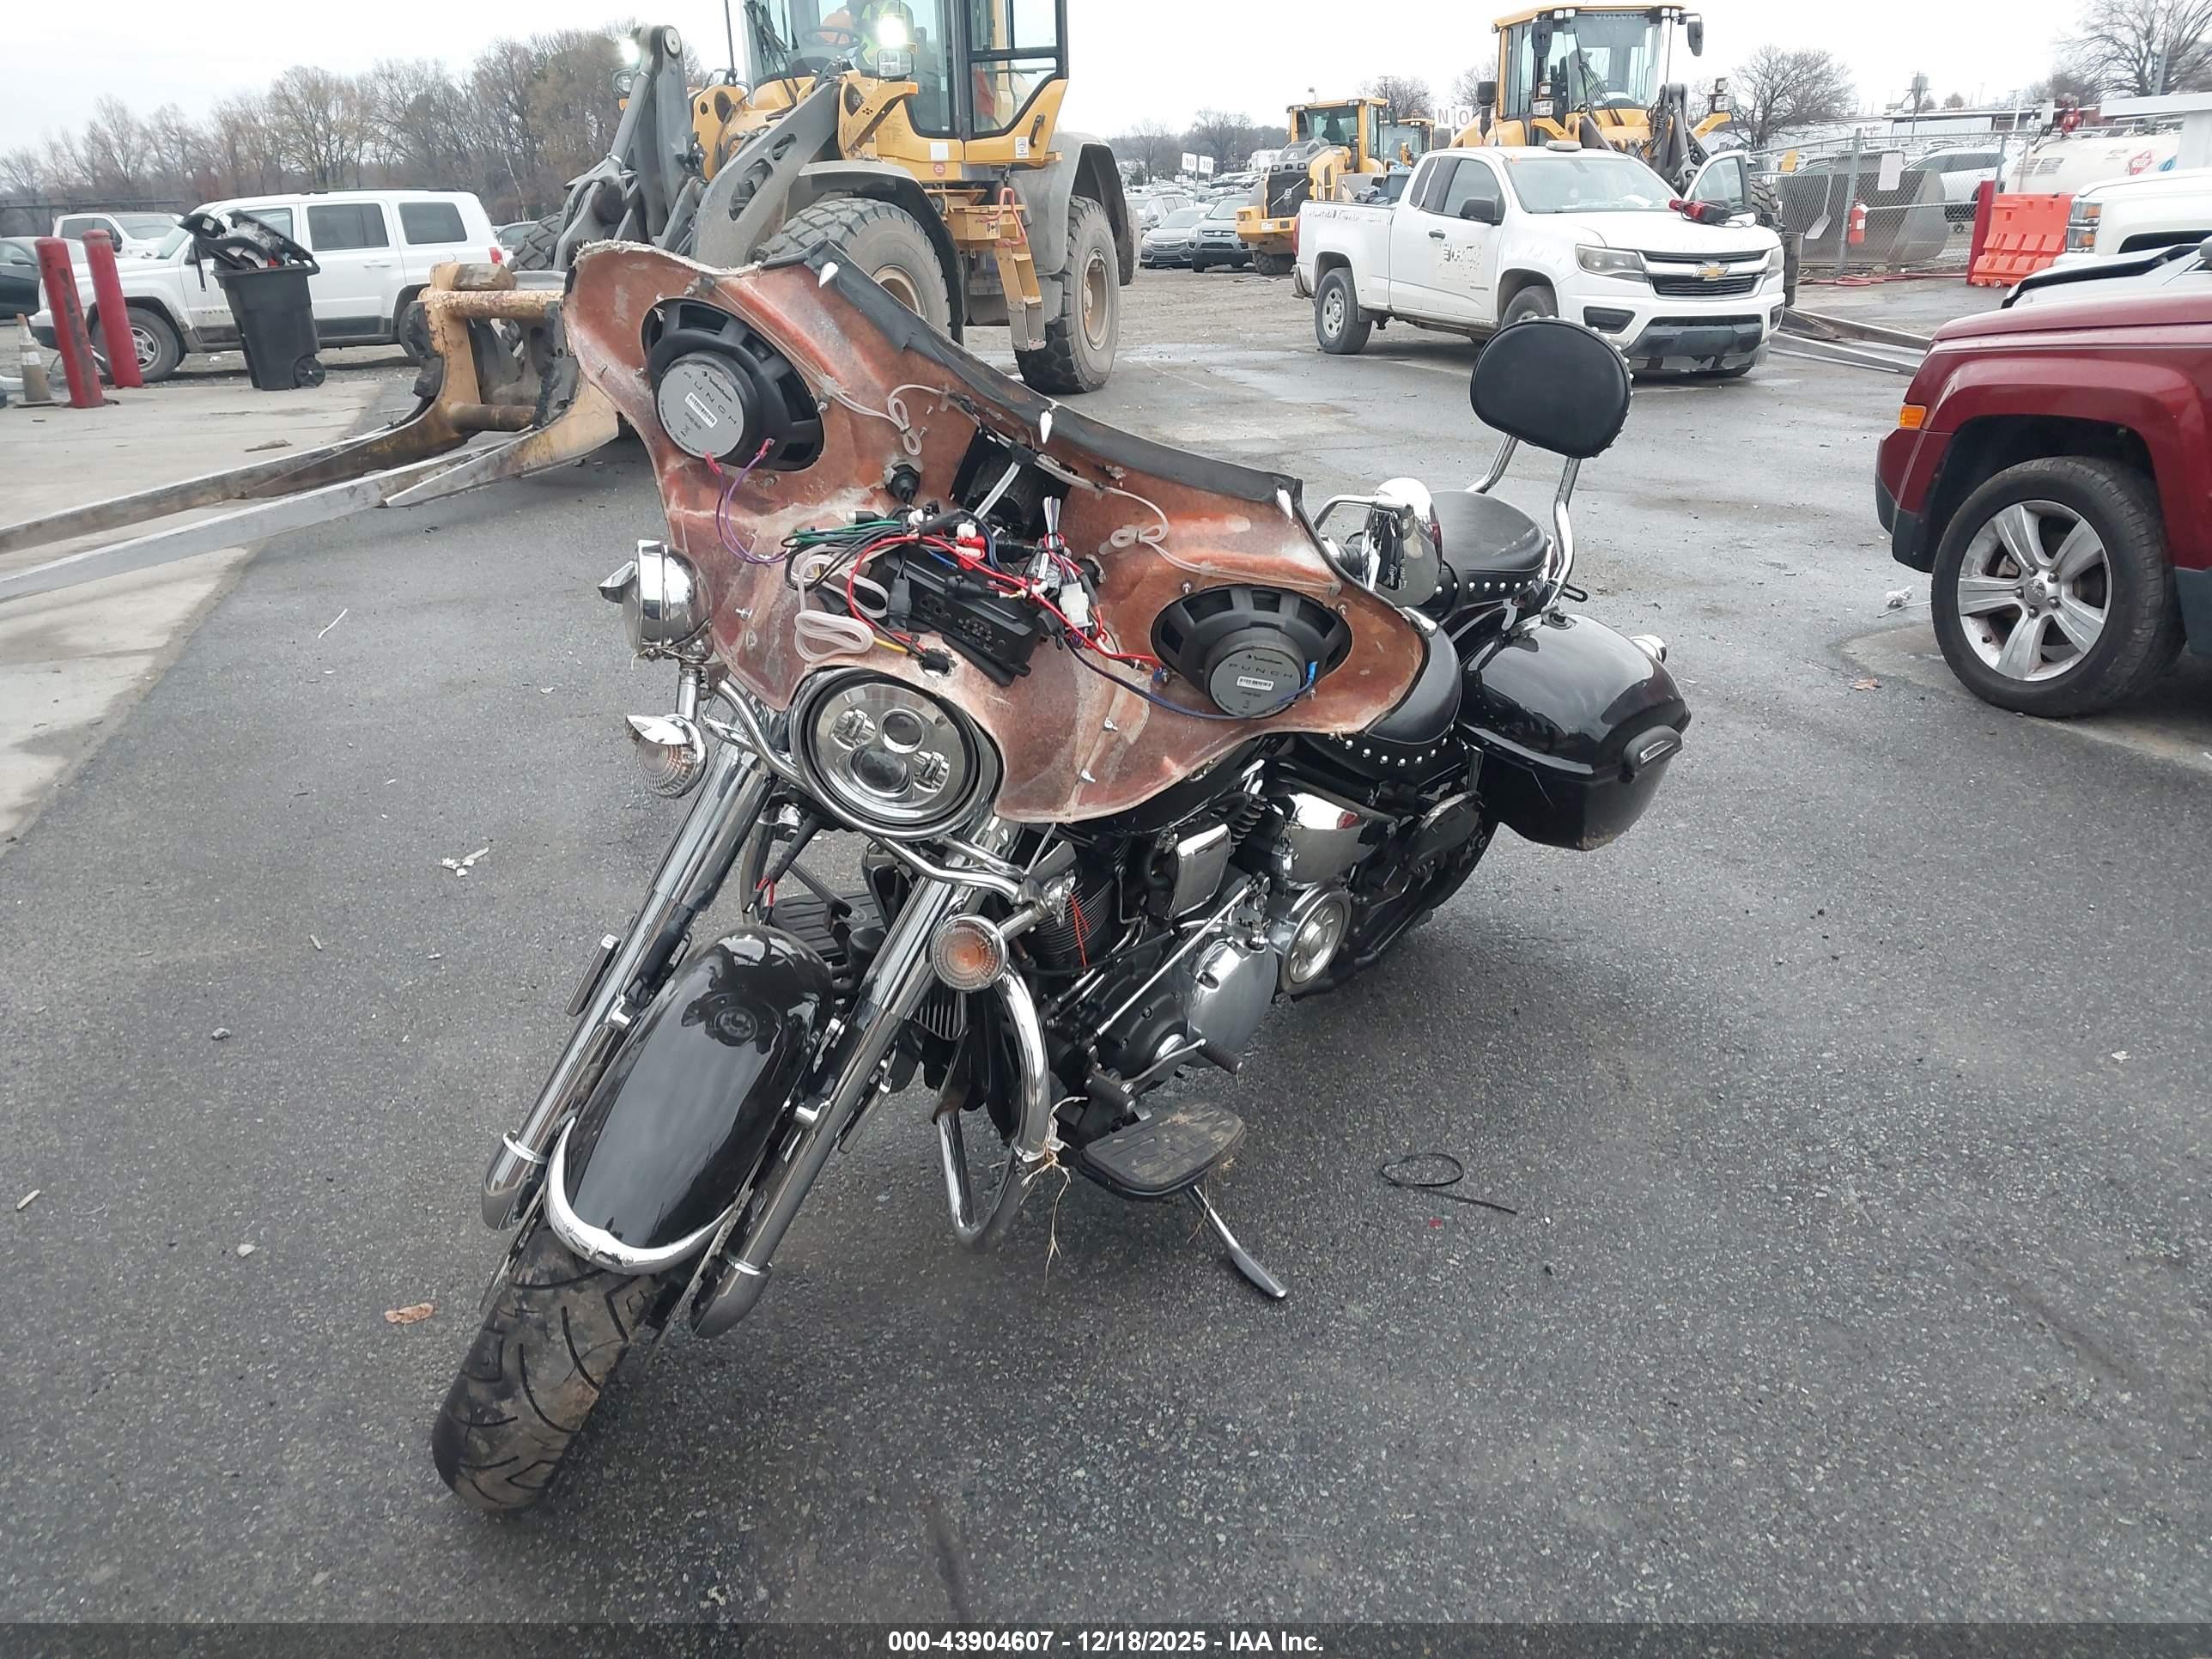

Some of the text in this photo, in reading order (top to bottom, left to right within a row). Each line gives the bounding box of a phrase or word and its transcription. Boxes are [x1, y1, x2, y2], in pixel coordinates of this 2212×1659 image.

[1438, 108, 1449, 124] N
[1185, 157, 1212, 170] 10 10
[1229, 663, 1293, 679] PUNCH
